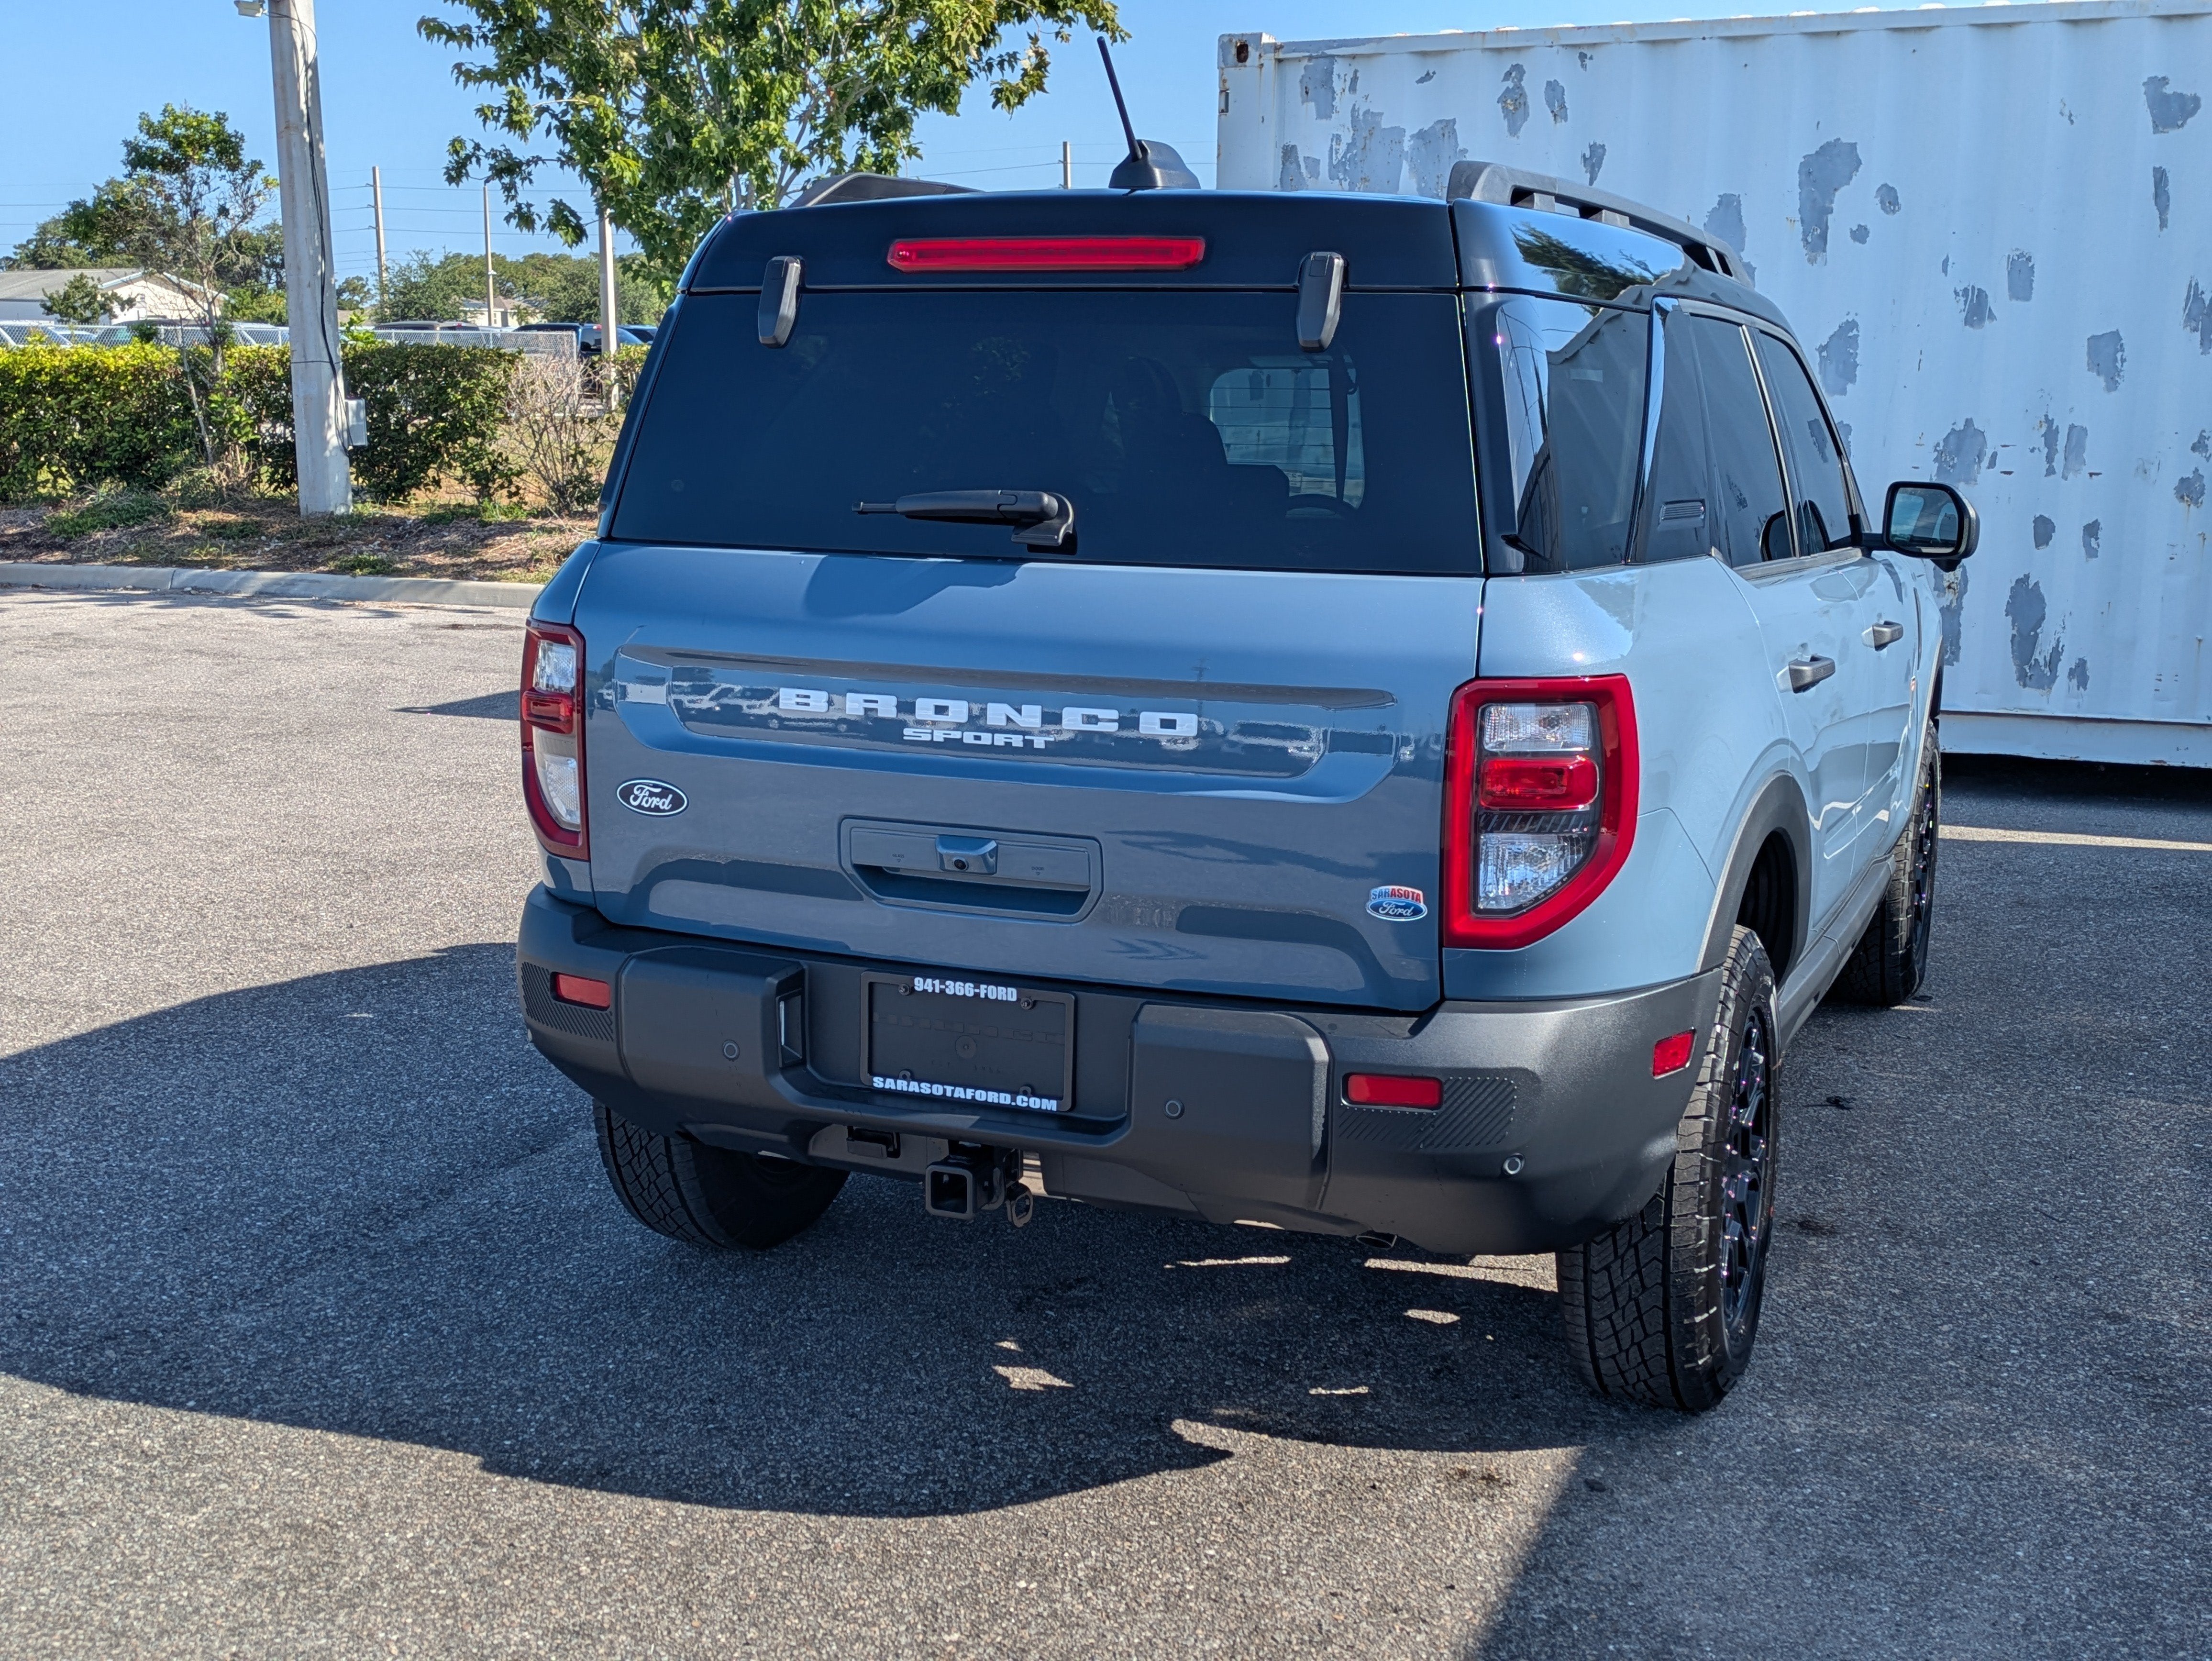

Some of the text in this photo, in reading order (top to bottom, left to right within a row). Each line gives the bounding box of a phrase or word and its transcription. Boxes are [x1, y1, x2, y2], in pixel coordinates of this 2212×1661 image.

[779, 687, 1198, 737] BRONCO
[903, 728, 1055, 749] SPORT
[630, 784, 673, 810] Ford
[1371, 888, 1422, 904] SARASOTA
[1378, 900, 1415, 916] Ford
[914, 976, 1018, 1002] 941-366-FORD
[872, 1076, 1057, 1111] SARASOTAFORD.COM
